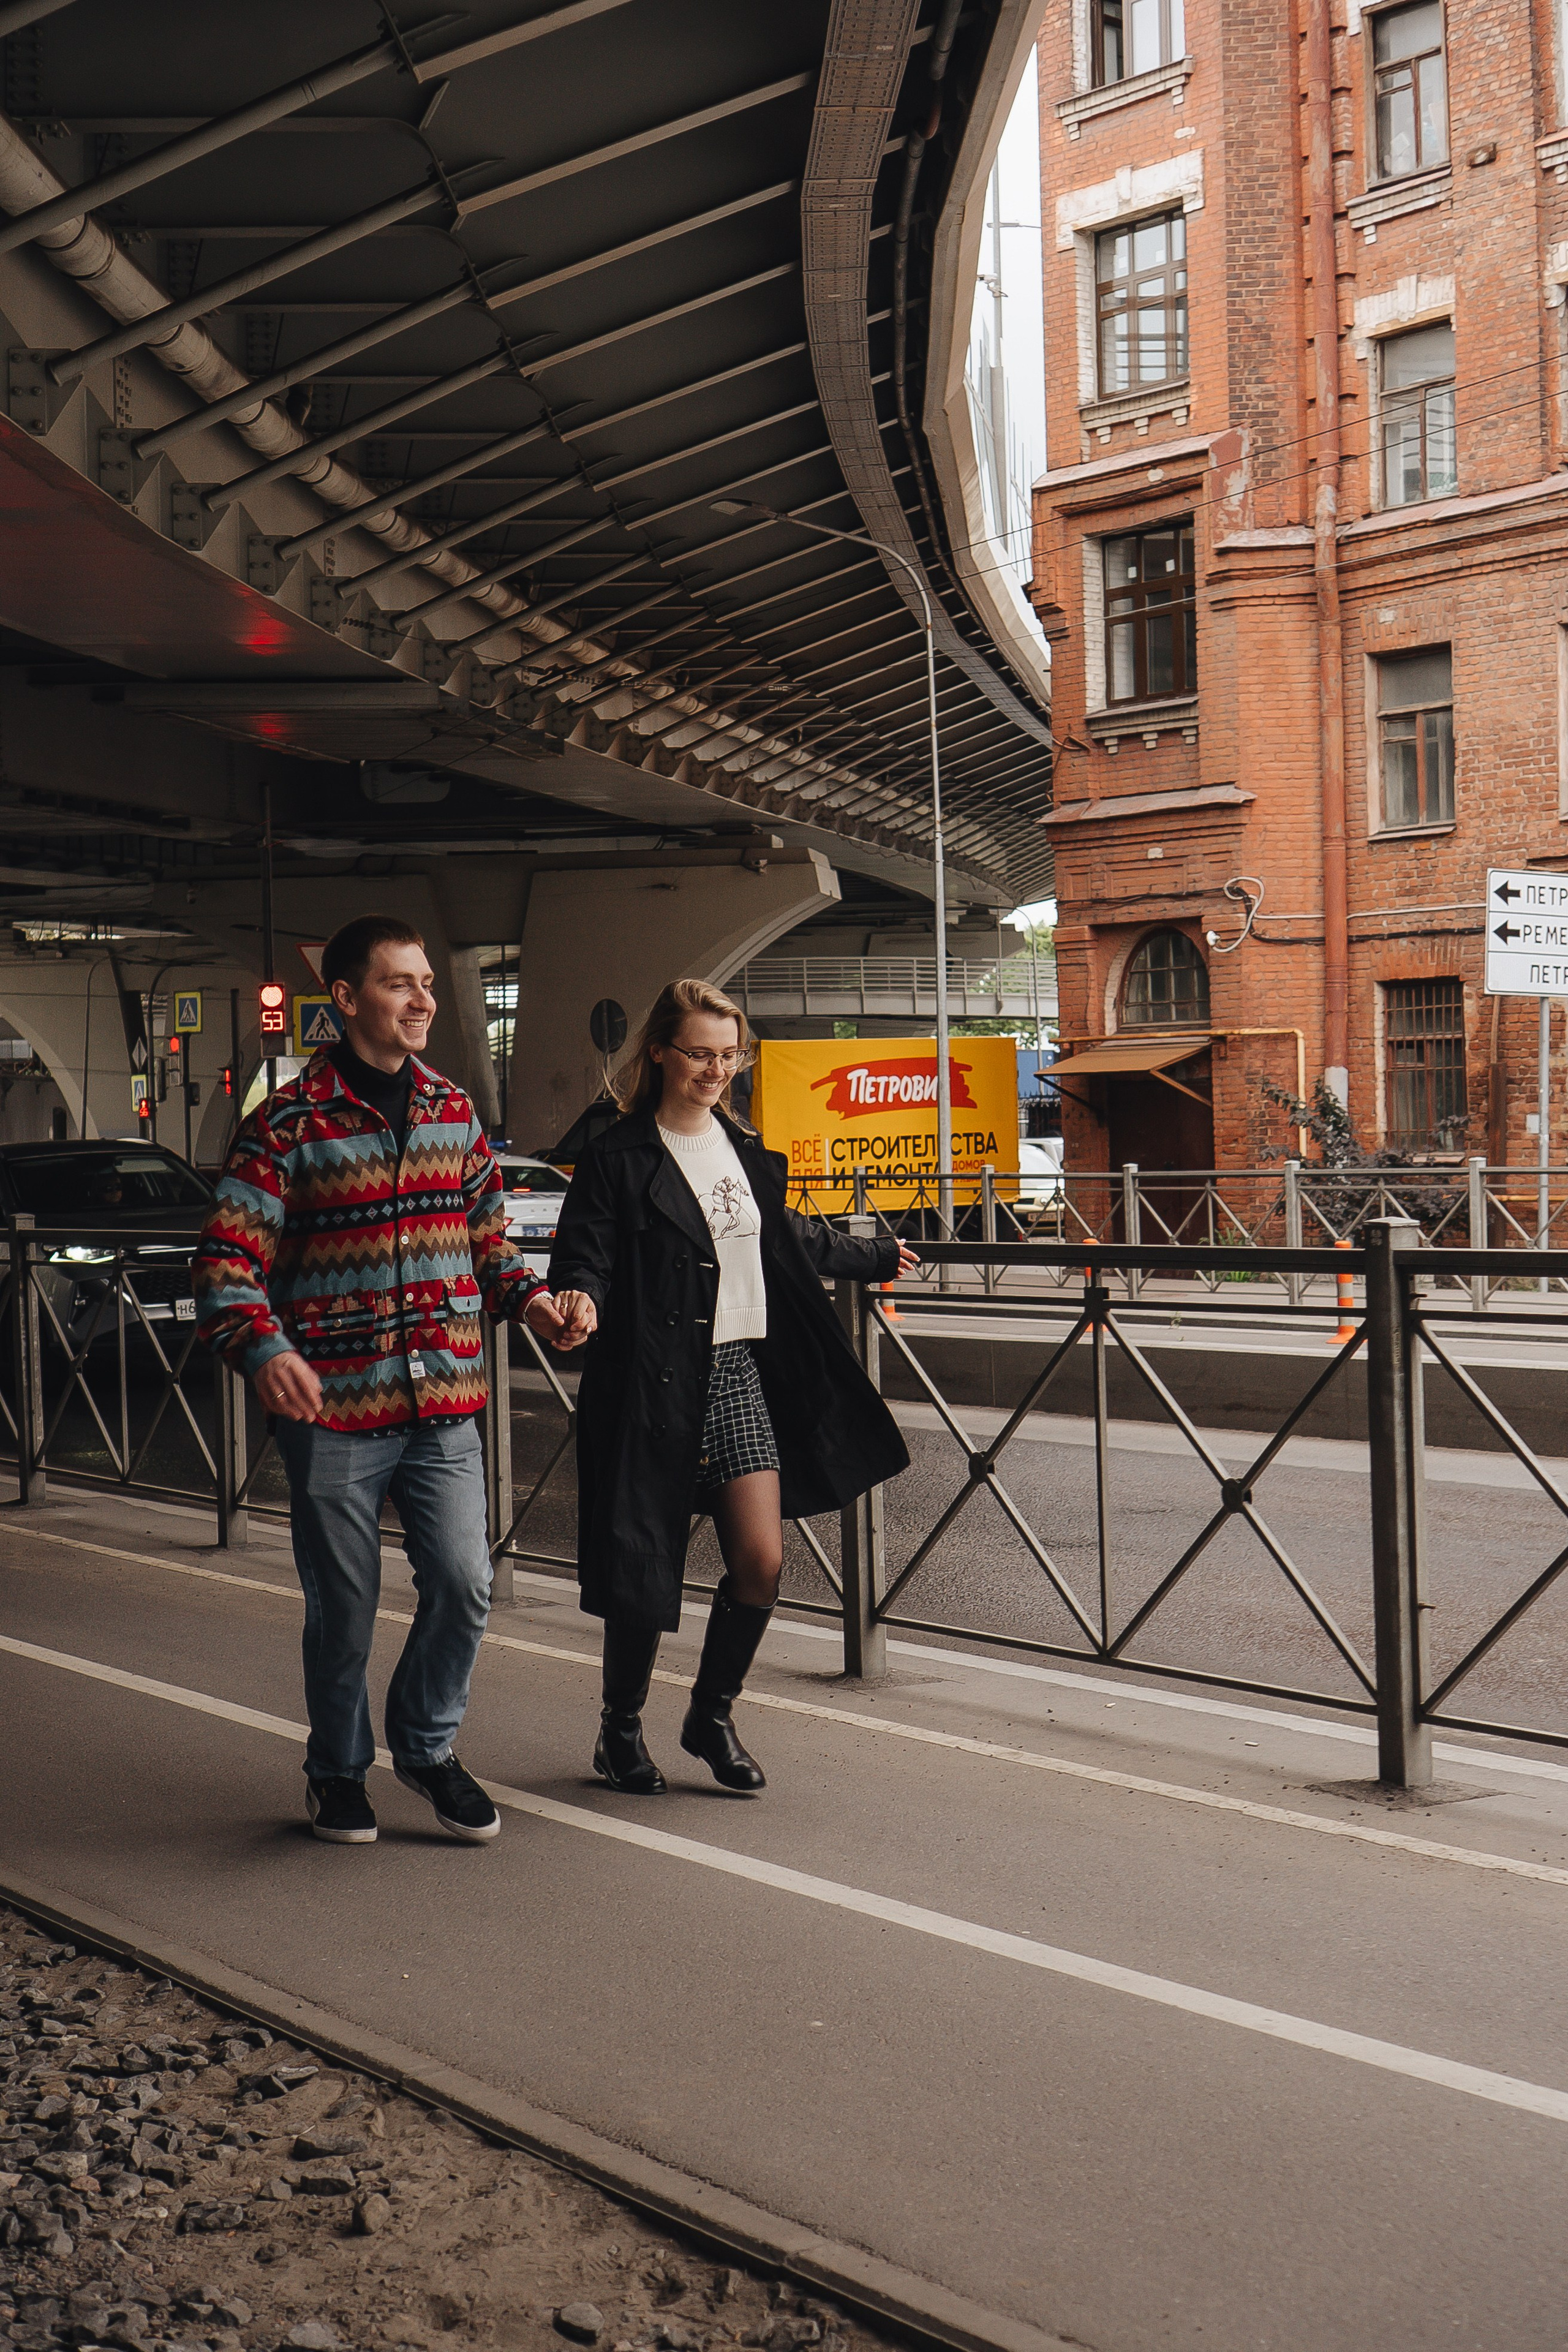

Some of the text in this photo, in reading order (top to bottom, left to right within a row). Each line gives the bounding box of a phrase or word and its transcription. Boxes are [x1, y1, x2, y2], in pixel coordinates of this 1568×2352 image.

[1526, 885, 1568, 906] ПЕТР
[1523, 925, 1568, 945] РЕМЕ
[262, 1011, 283, 1030] 53
[791, 1133, 822, 1163] ВСЁ
[831, 1131, 999, 1162] СТРОИТЕЛСТВА
[864, 1161, 940, 1189] ЕМОНТ
